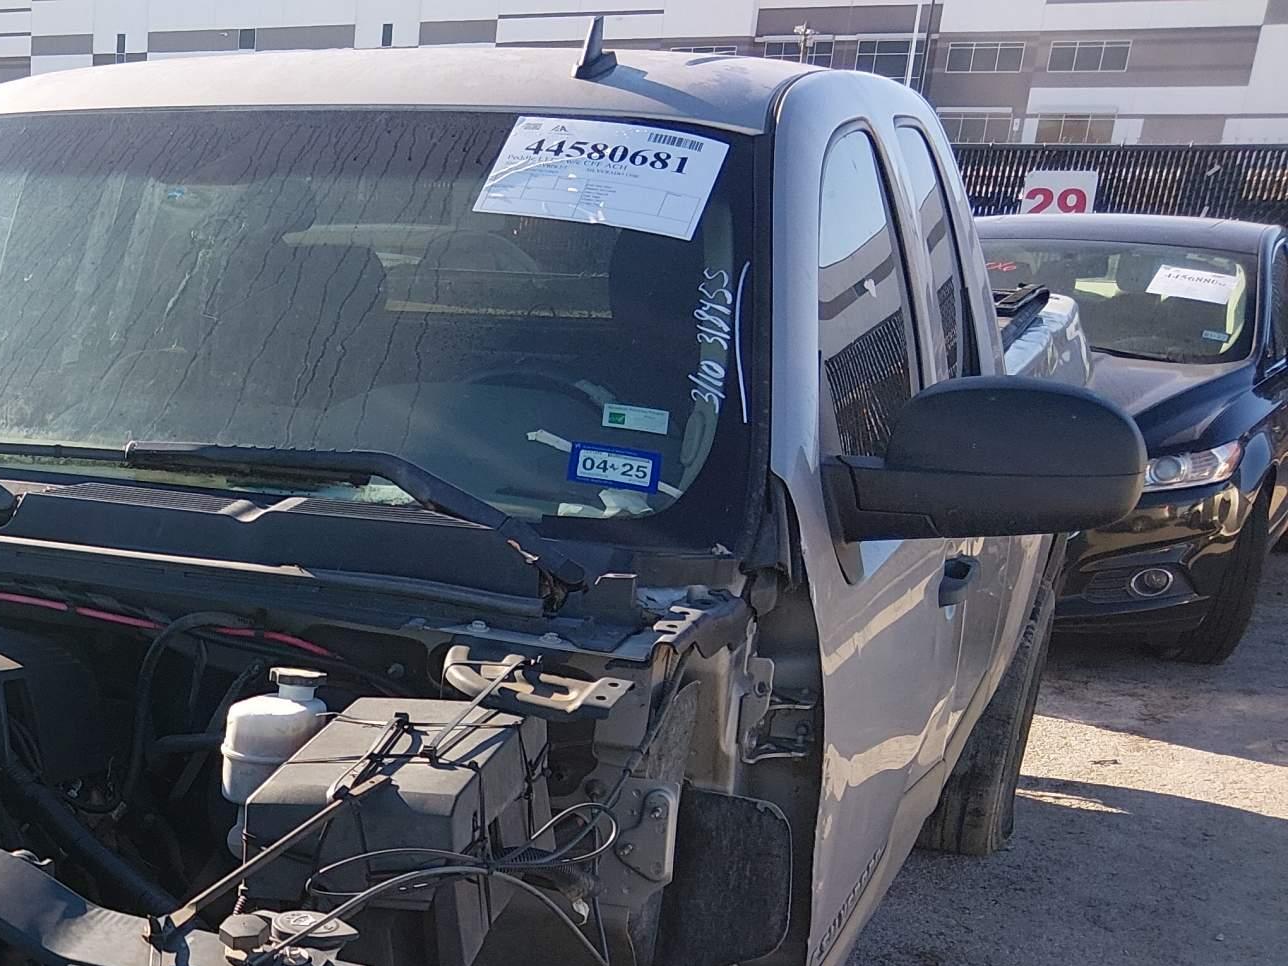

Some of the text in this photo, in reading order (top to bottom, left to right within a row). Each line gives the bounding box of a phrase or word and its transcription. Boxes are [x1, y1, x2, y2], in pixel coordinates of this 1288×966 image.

[525, 138, 689, 175] 44580681
[1025, 187, 1087, 213] 29
[582, 457, 648, 479] 04 25
